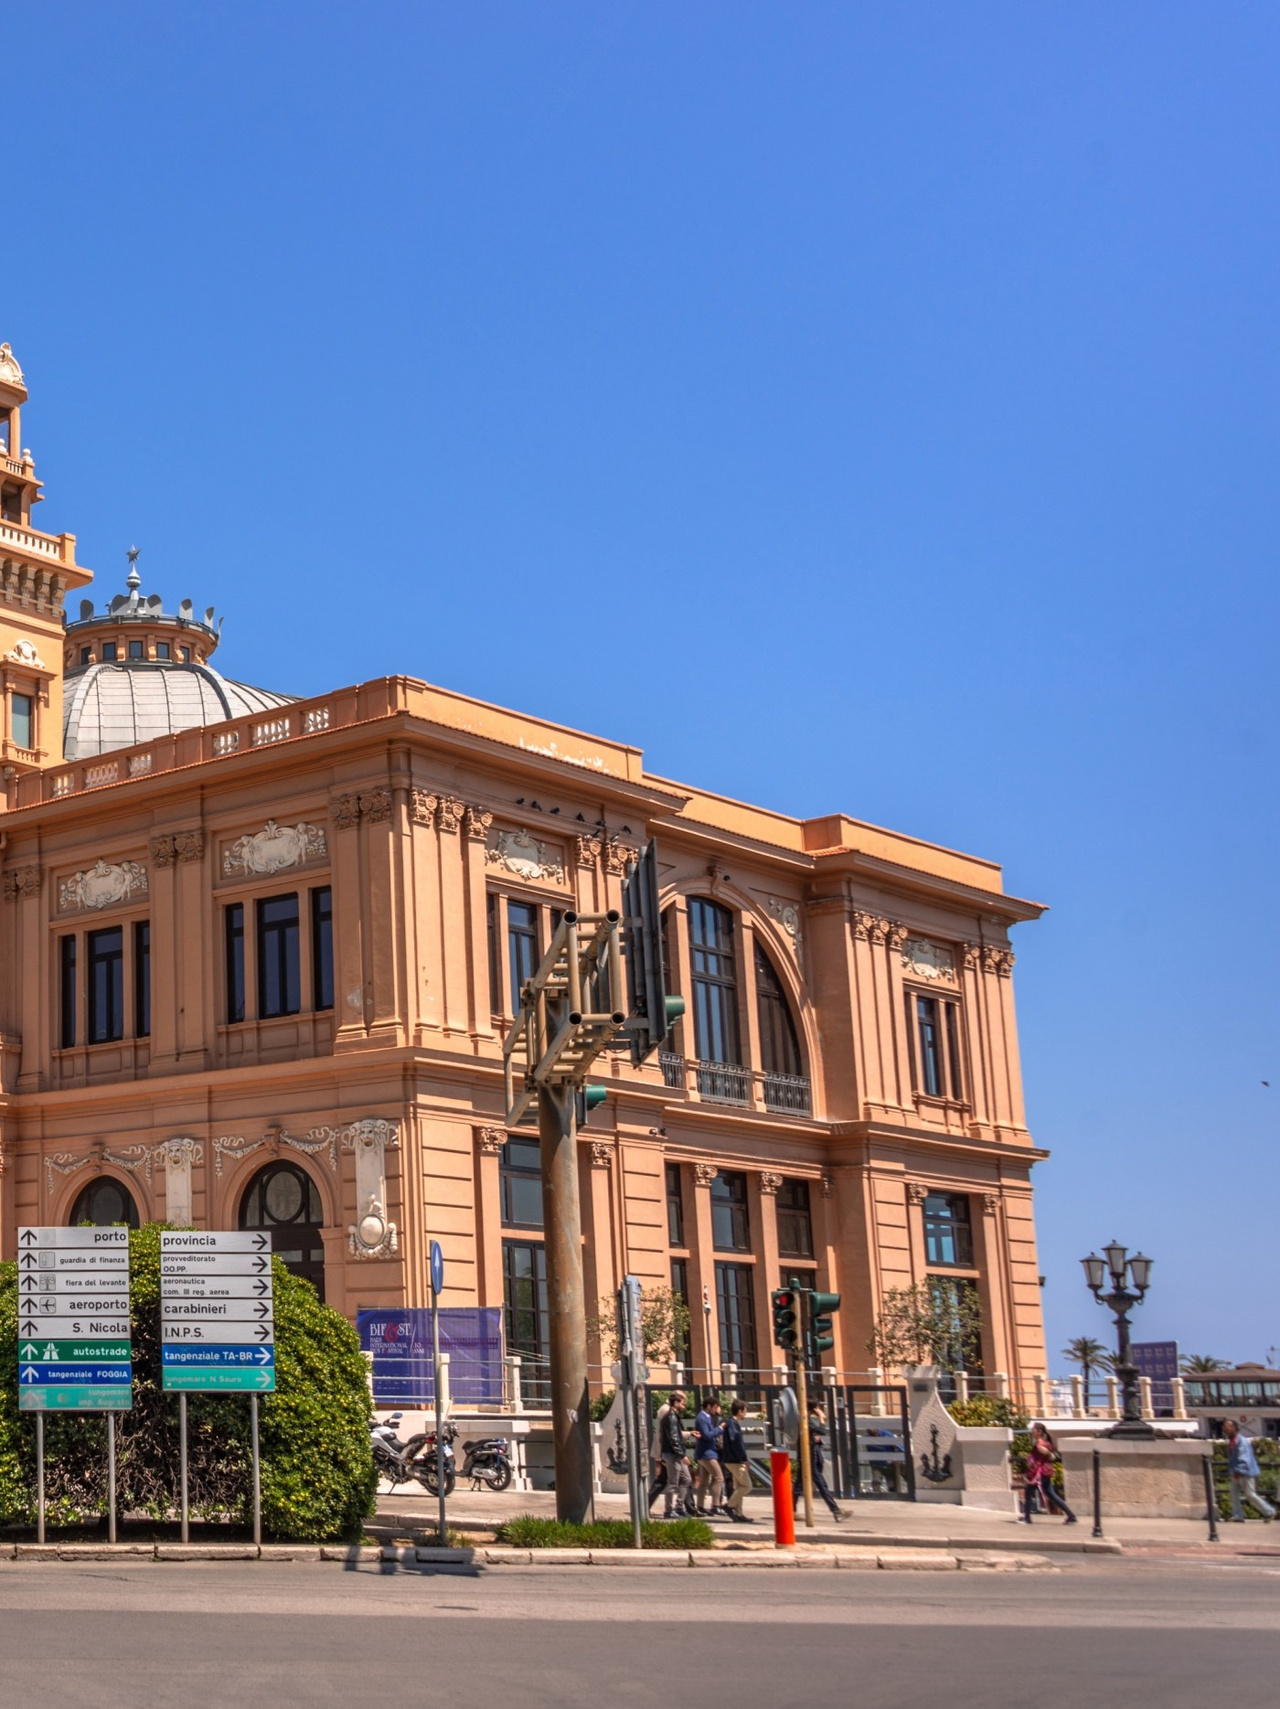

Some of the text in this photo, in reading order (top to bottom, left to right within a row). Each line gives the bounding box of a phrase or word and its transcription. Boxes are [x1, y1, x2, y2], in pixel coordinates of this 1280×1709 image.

[94, 1231, 127, 1243] porto
[163, 1235, 216, 1247] provincia
[60, 1257, 86, 1265] guardia
[163, 1255, 216, 1263] provveditorato
[163, 1265, 188, 1273] OO.PP.
[69, 1299, 128, 1311] aeroporto
[164, 1303, 226, 1314] carabinieri
[72, 1322, 128, 1333] S. Nicola
[164, 1327, 204, 1338] I.N.P.S.
[73, 1347, 128, 1356] autostrade
[164, 1351, 253, 1362] tangenziale TA-BR
[48, 1370, 128, 1379] tangenziale FOGGIA
